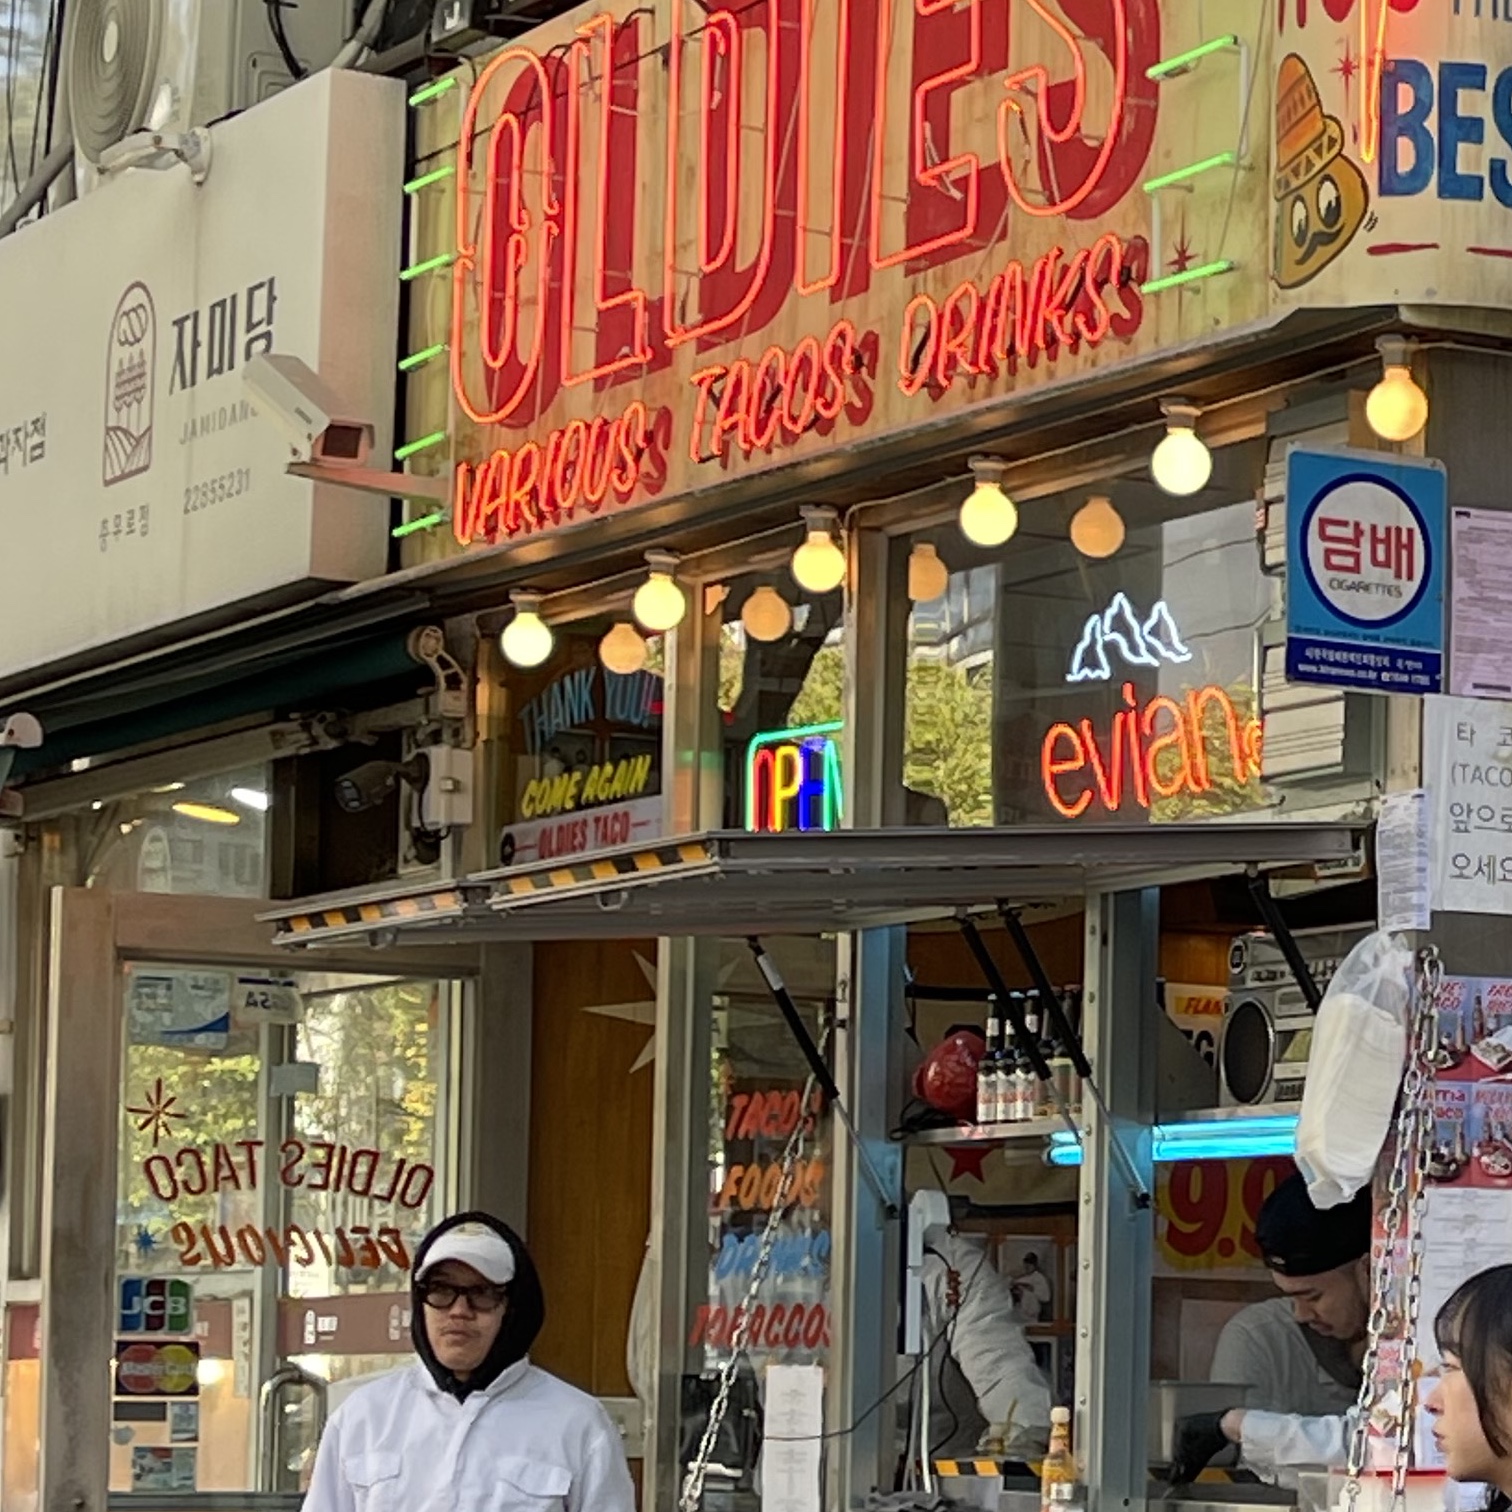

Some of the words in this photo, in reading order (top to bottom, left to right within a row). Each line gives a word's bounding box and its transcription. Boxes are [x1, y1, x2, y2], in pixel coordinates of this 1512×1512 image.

[452, 0, 1162, 428] OLDIES
[168, 276, 277, 395] 자미당
[180, 400, 258, 445] JAMIDAN
[455, 402, 671, 545] VARIOUS
[689, 320, 879, 463] TACOS
[898, 233, 1149, 398] DRINKS
[1317, 515, 1415, 583] 담배
[1330, 578, 1403, 599] CIGARETTES
[518, 666, 597, 757] THANK
[1041, 683, 1249, 820] evian
[521, 777, 584, 819] COME
[582, 755, 652, 810] AGAIN
[538, 822, 589, 862] OLDIES
[593, 811, 632, 848] TACO
[120, 1296, 187, 1315] JCB
